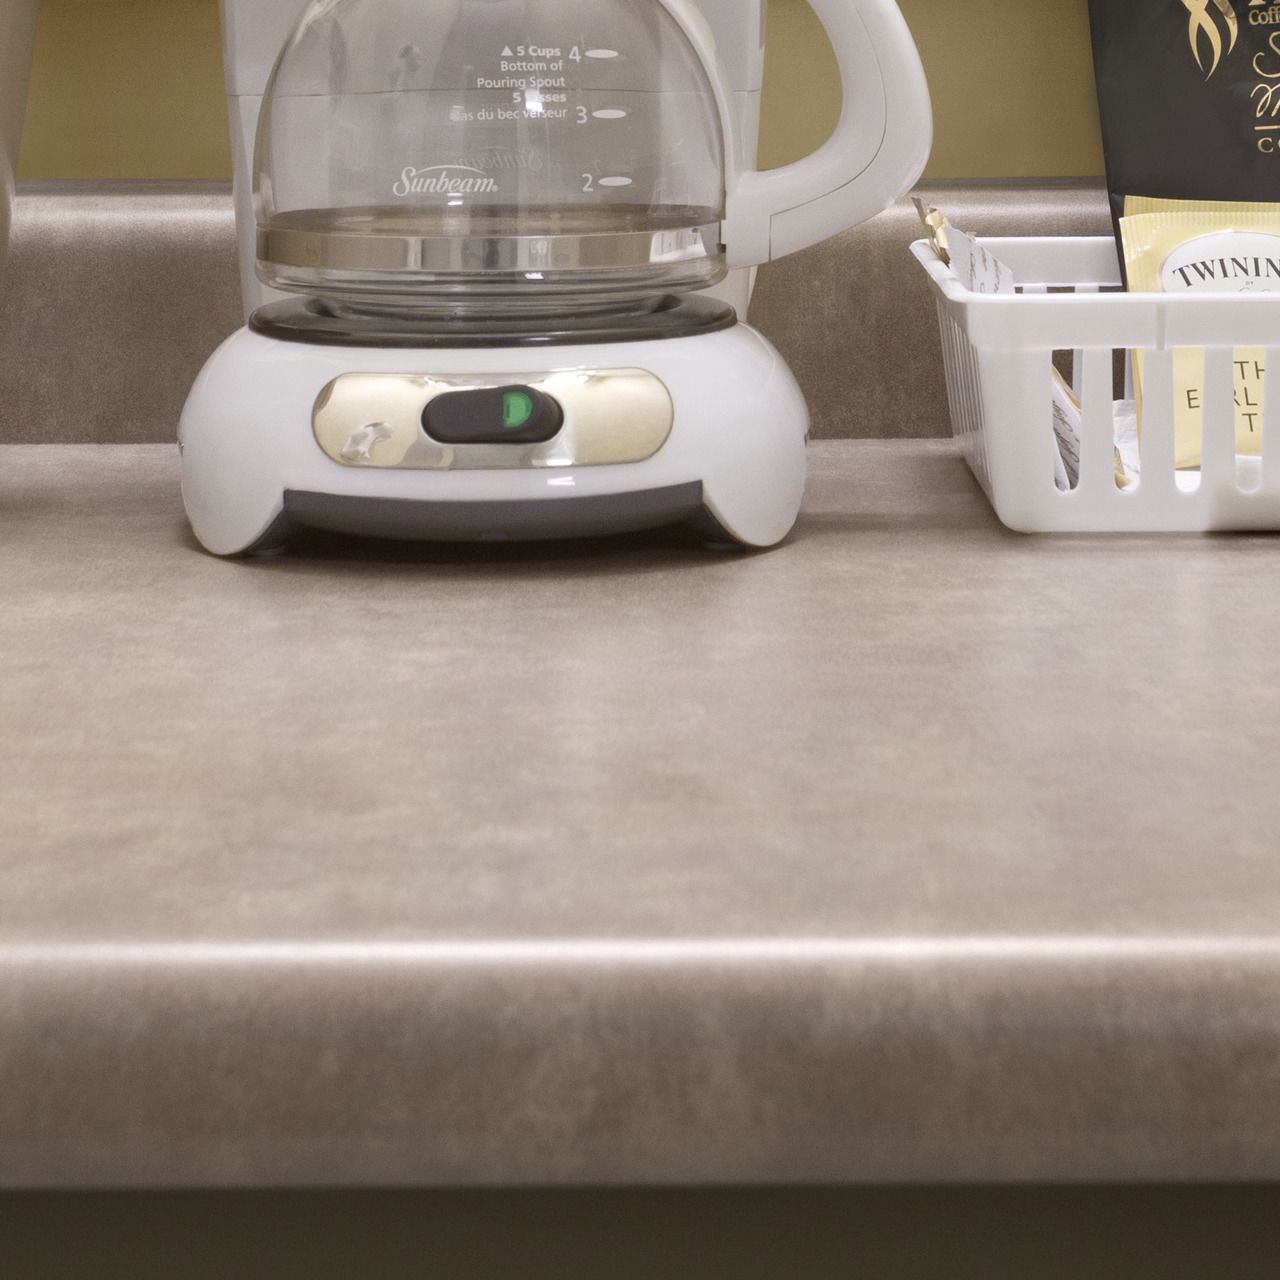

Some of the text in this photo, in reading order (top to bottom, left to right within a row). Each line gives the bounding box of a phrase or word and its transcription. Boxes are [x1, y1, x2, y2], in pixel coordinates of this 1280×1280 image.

[516, 45, 561, 59] 5 Cups
[568, 45, 582, 63] 4
[500, 59, 564, 72] Bottom of
[477, 76, 566, 91] Pouring Spout
[512, 92, 521, 103] 5
[477, 107, 494, 121] du
[497, 107, 520, 121] bec
[522, 109, 569, 120] verseur
[576, 105, 588, 124] 3
[393, 165, 499, 197] Sunbeam
[581, 173, 594, 192] 2
